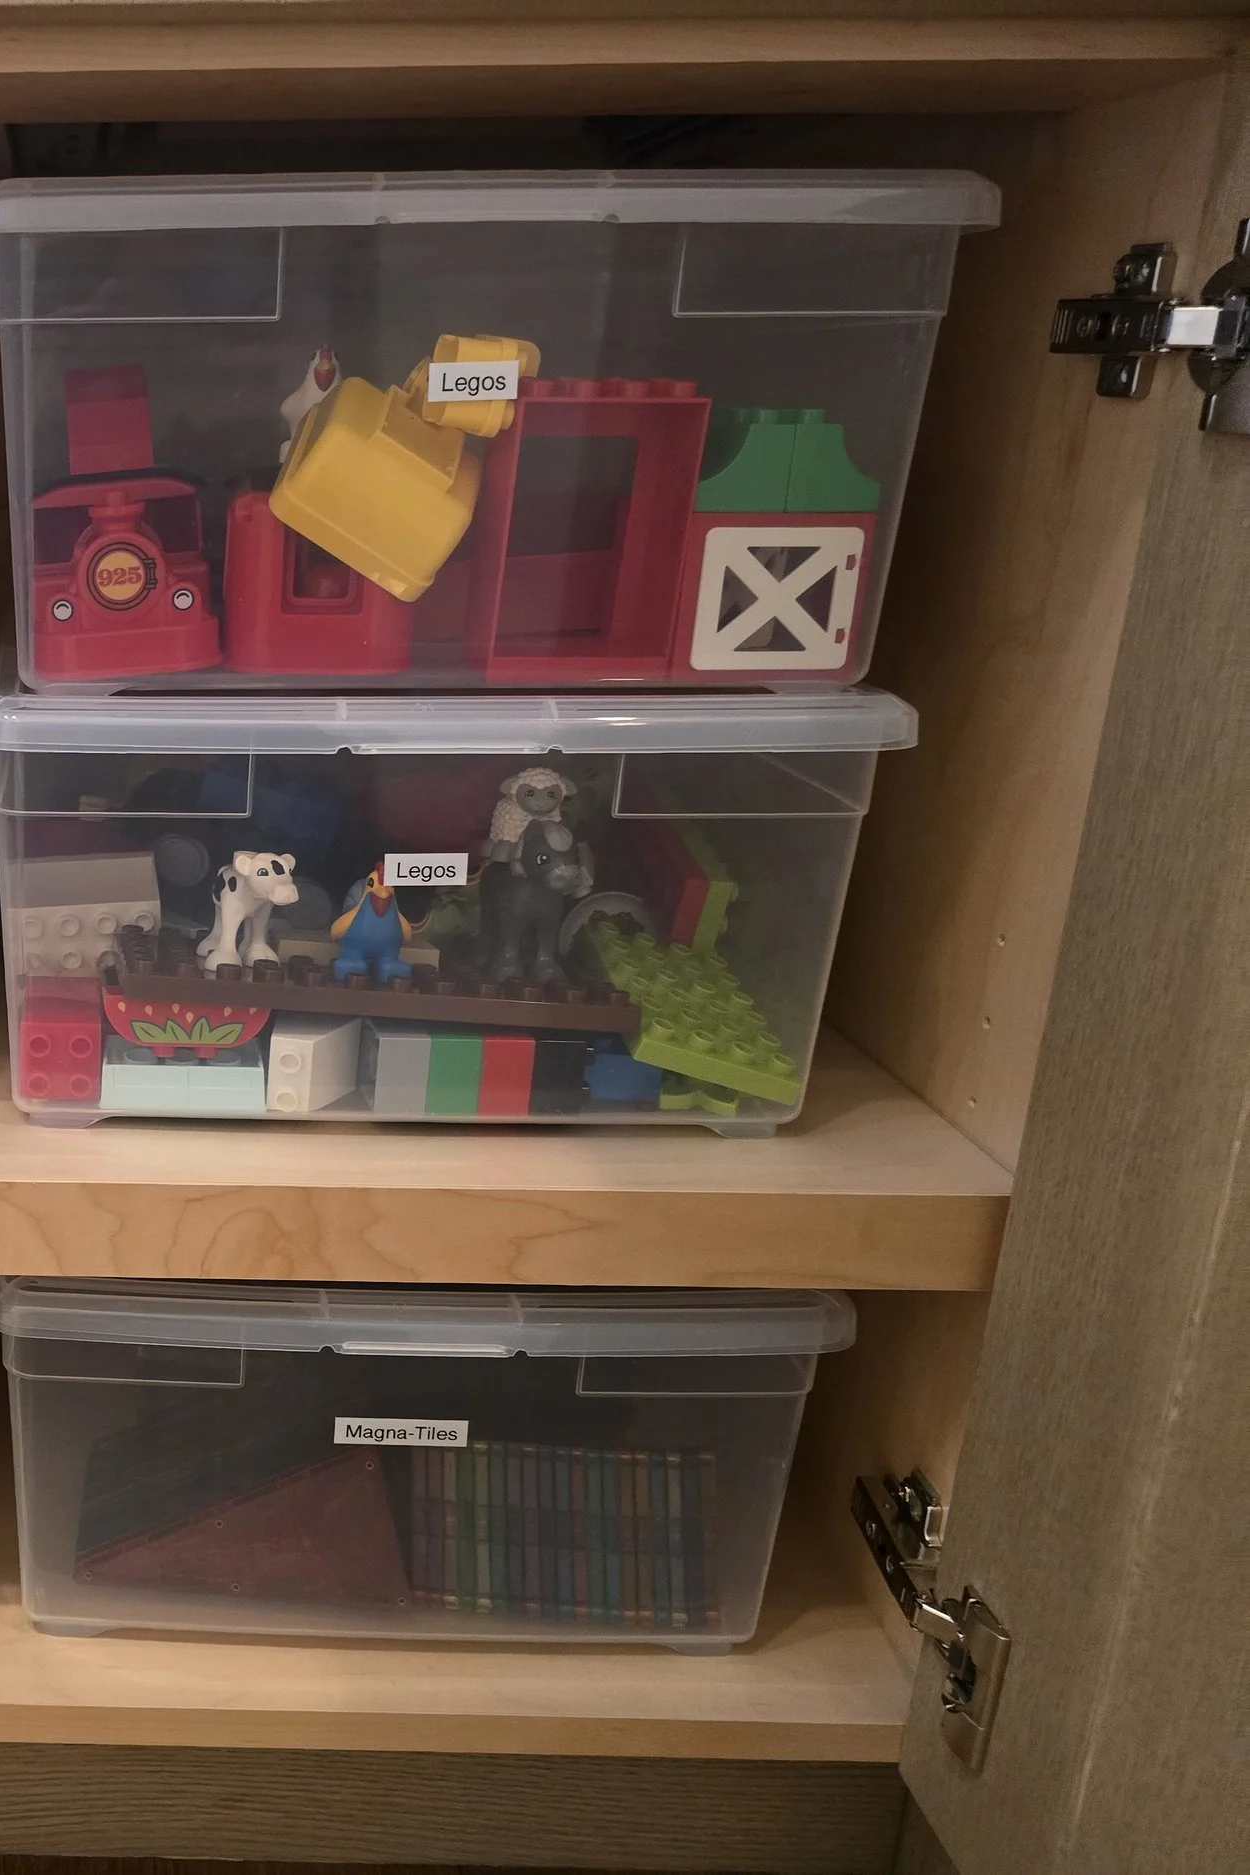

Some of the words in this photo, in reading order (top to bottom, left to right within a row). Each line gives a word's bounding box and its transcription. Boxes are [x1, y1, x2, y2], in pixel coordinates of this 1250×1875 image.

[441, 372, 507, 397] Legos
[97, 565, 143, 588] 925
[396, 862, 457, 883] Legos
[345, 1424, 459, 1442] Magna-Tiles
